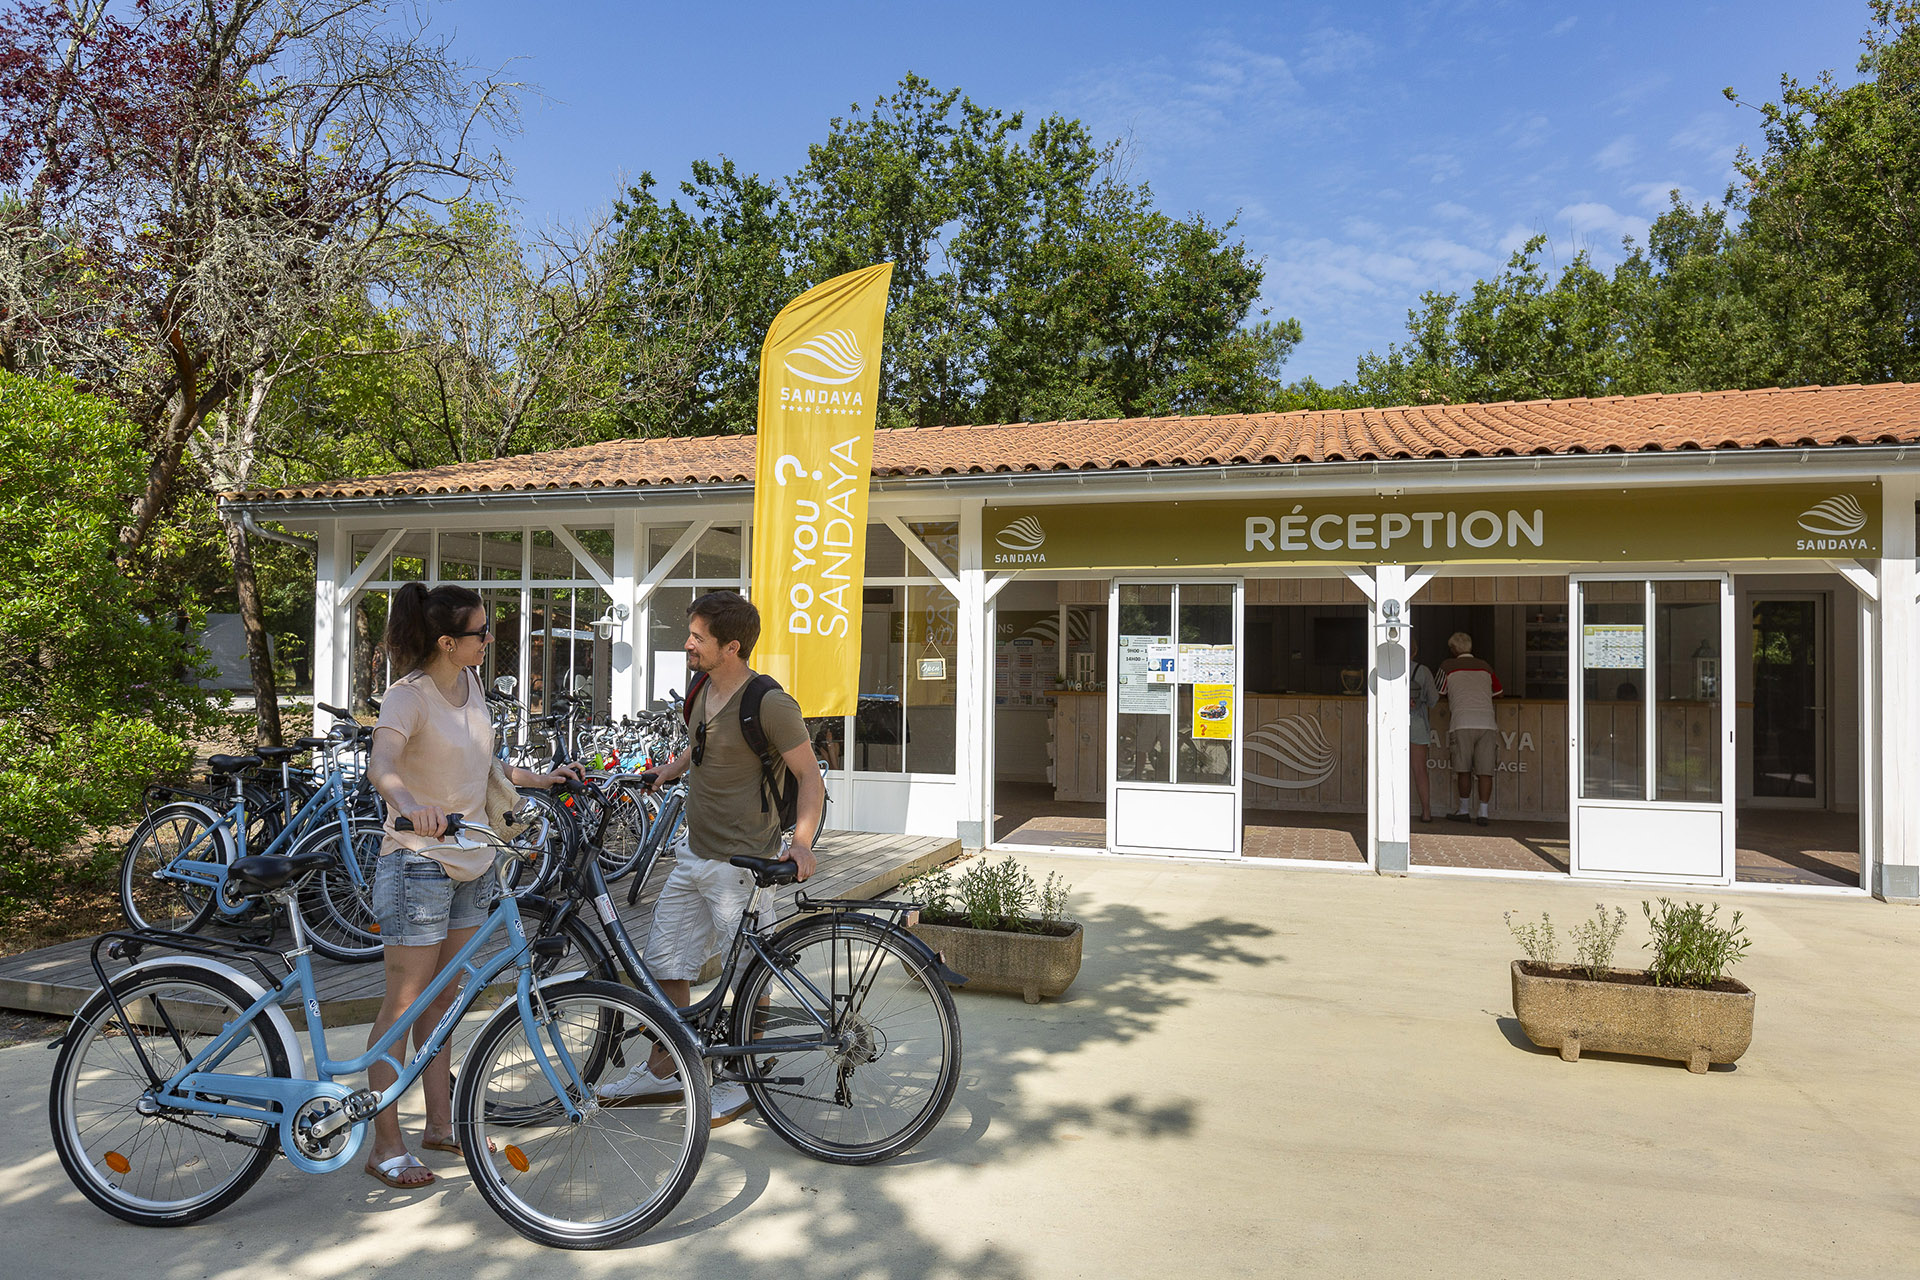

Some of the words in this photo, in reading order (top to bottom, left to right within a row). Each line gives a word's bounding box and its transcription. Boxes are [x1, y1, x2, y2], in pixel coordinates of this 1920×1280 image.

[780, 387, 863, 406] SANDAYA
[792, 499, 820, 572] YOU
[817, 435, 861, 639] SANDAYA
[1245, 504, 1544, 552] RÉCEPTION
[1796, 538, 1868, 551] SANDAYA
[994, 553, 1046, 564] SANDAYA
[788, 582, 815, 635] DO
[920, 663, 940, 673] Open
